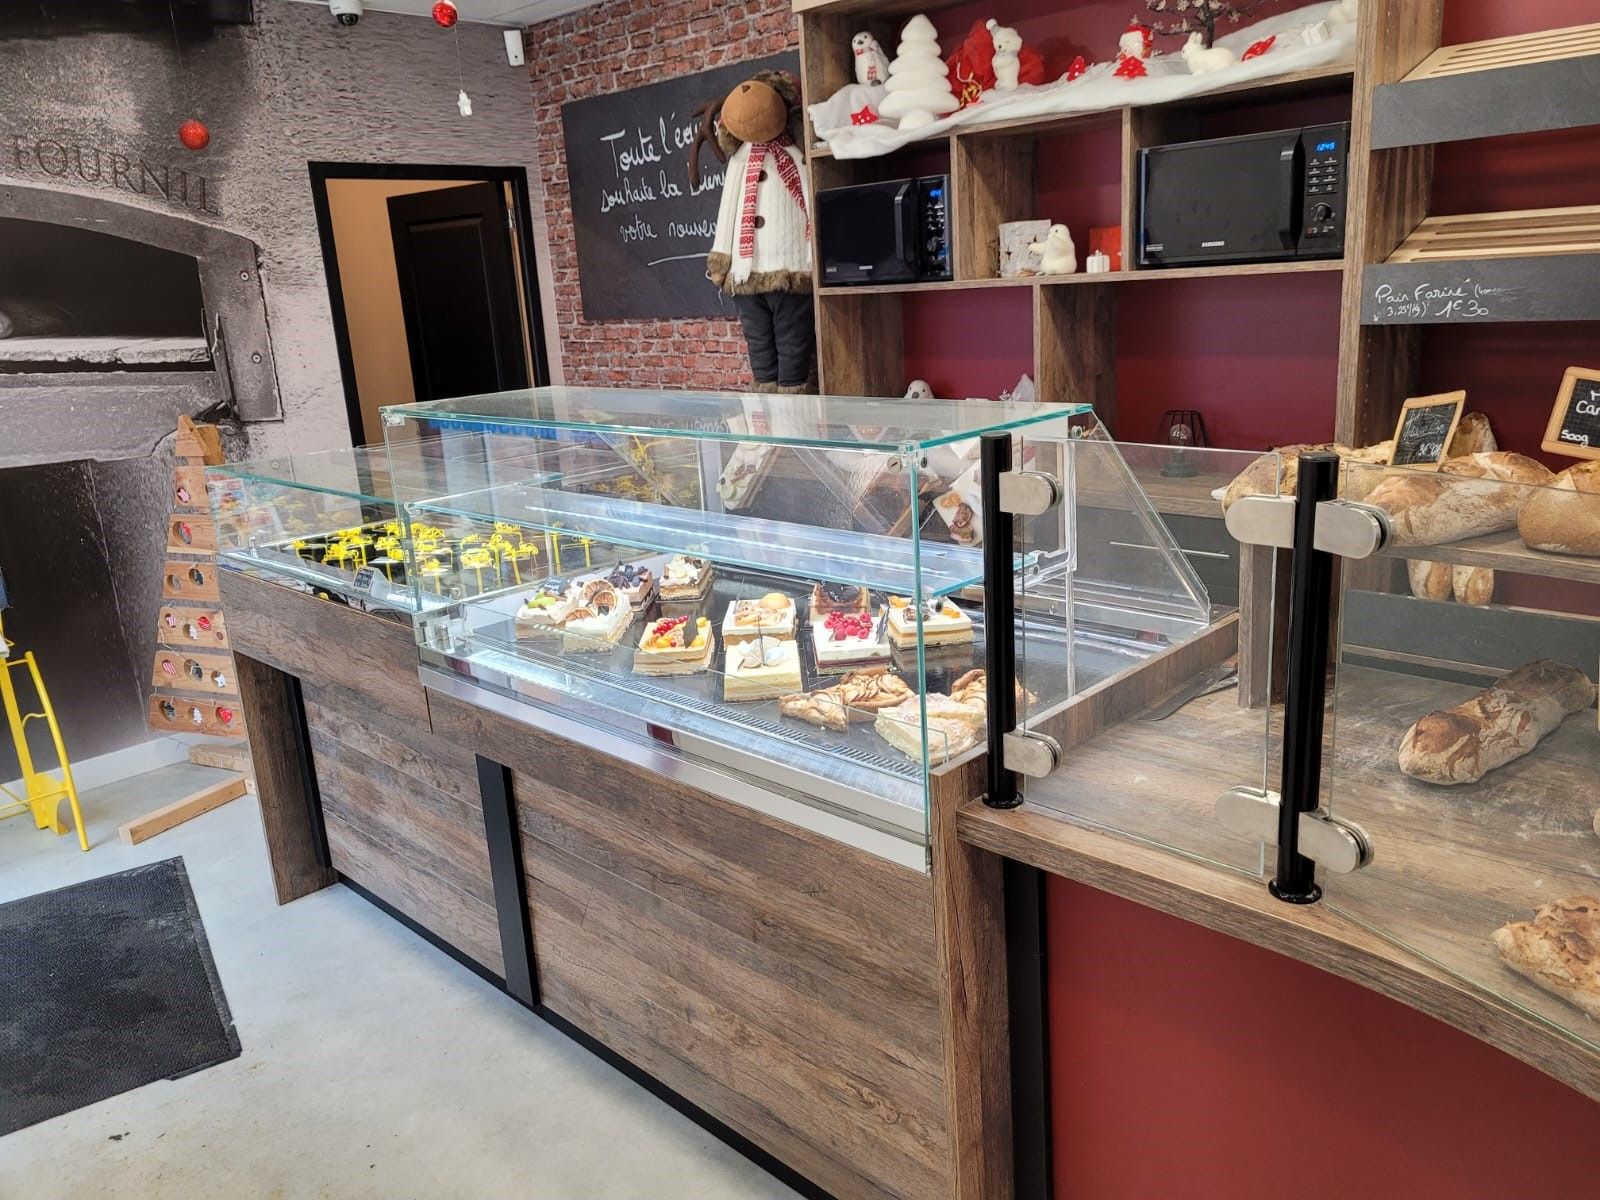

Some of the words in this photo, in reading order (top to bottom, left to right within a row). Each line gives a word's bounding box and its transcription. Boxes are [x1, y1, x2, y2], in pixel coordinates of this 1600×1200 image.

[600, 126, 662, 178] Toute
[11, 134, 223, 215] FOURNIL
[600, 177, 657, 213] souhaite
[660, 169, 683, 199] la
[620, 214, 658, 243] votre
[1375, 284, 1409, 304] Pain
[1414, 278, 1471, 300] Fariné
